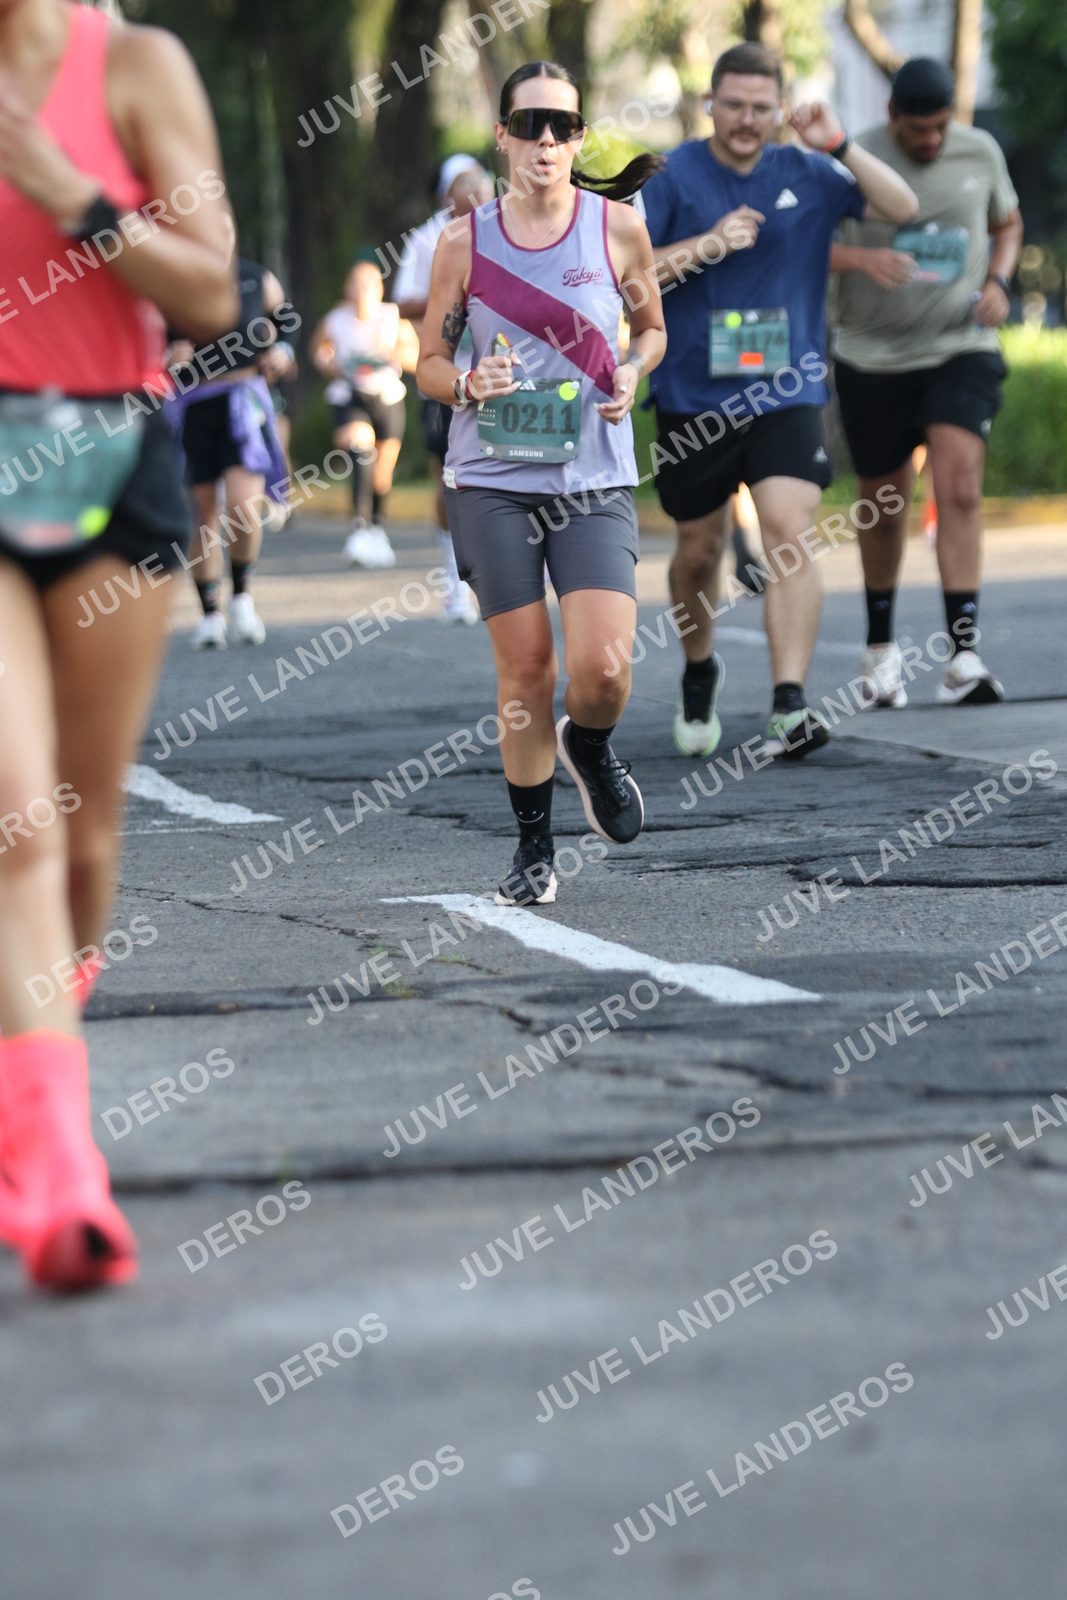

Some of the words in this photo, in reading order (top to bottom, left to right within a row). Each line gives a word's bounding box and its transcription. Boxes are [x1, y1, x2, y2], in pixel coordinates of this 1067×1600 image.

[562, 266, 604, 287] Tokyo
[502, 402, 576, 434] 0211
[509, 449, 544, 458] SAMSUNG
